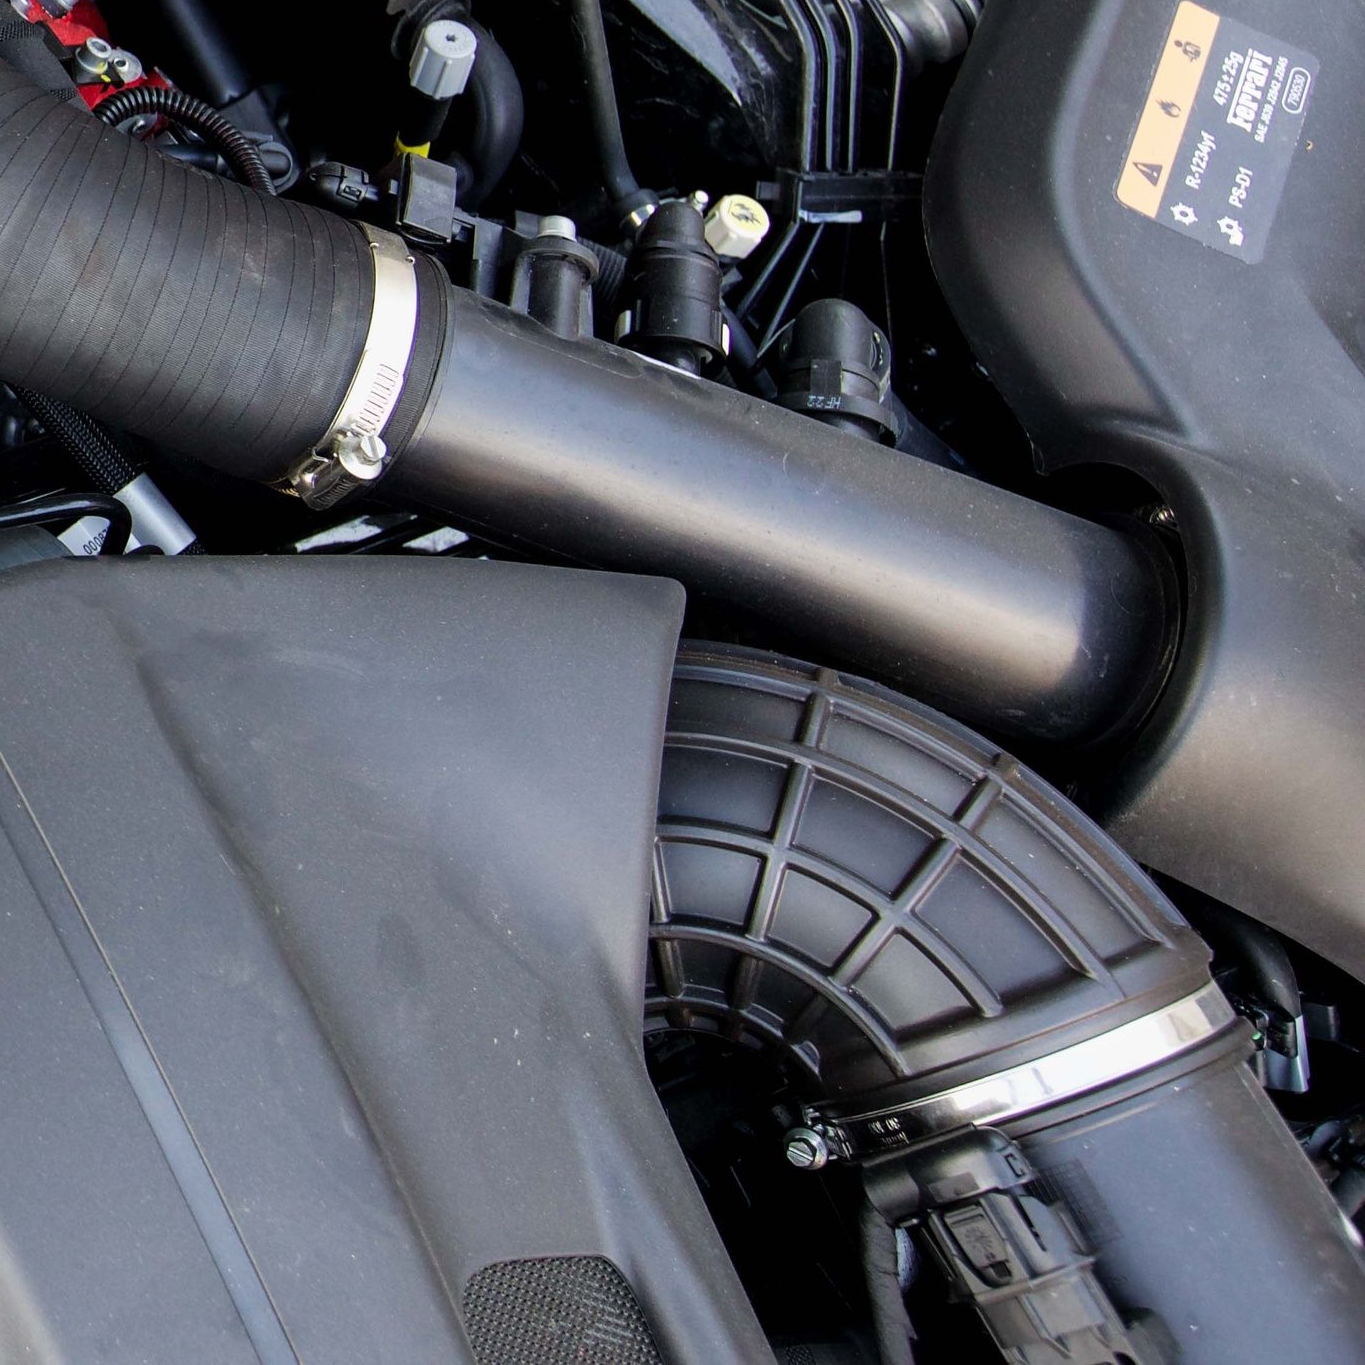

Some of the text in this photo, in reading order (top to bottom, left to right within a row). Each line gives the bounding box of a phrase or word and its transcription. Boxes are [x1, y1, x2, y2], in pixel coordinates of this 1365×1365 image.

[1227, 48, 1273, 133] Ferrari
[1185, 130, 1216, 190] R-1234yf
[1229, 167, 1253, 208] PS-D1
[807, 395, 842, 410] HF22
